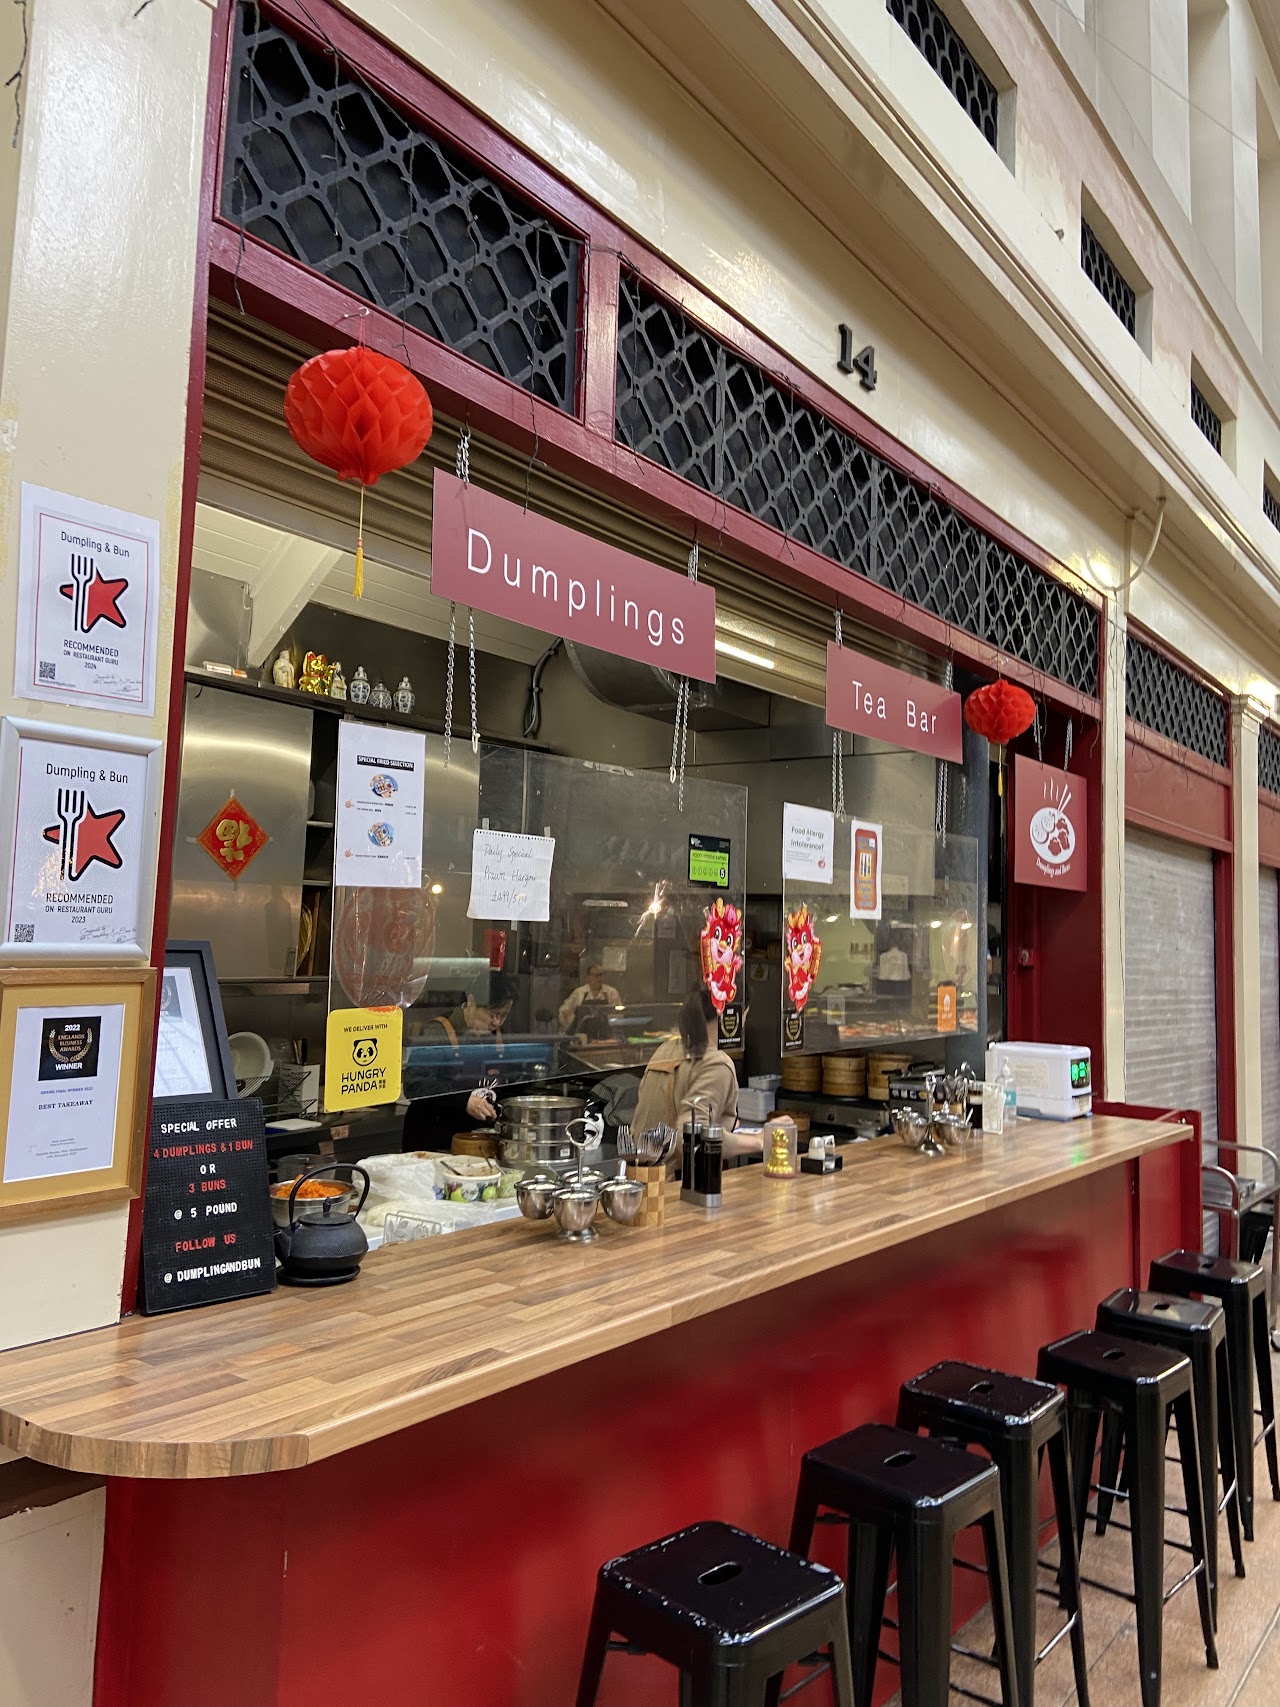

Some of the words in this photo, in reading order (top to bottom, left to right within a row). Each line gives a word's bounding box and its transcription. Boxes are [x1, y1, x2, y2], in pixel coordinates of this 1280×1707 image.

[837, 324, 877, 391] 14
[60, 531, 102, 553] Dumpling
[104, 543, 111, 553] &
[114, 545, 130, 558] Bun
[467, 528, 684, 647] Dumplings
[64, 639, 118, 658] RECOMMENDED
[73, 652, 104, 662] RESTAURANT
[84, 662, 96, 670] 2024
[852, 680, 886, 720] Tea
[906, 700, 936, 734] Bar
[390, 760, 414, 768] SELECTION
[46, 763, 95, 782] Dumpling
[100, 770, 106, 781] &
[110, 771, 128, 784] Bun
[792, 826, 806, 836] Food
[806, 829, 824, 840] Allergy
[790, 840, 824, 851] Intolerance?
[484, 844, 502, 862] Daily
[508, 847, 532, 863] Special
[484, 866, 506, 880] Prawn
[46, 892, 114, 904] RECOMMENDED
[58, 906, 96, 914] RESTAURANT
[56, 1062, 82, 1070] WINNER
[342, 1067, 386, 1082] HUNGRY
[342, 1080, 378, 1095] PANDA
[58, 1100, 93, 1108] TAKEAWAY
[160, 1122, 200, 1134] SPECIAL
[206, 1118, 237, 1130] OFFER
[153, 1148, 160, 1158] 4
[162, 1144, 217, 1158] DUMPLINGS
[220, 1142, 226, 1152] &
[228, 1142, 234, 1152] 1
[236, 1140, 253, 1150] BUN
[200, 1164, 216, 1174] OR
[188, 1183, 195, 1193] 3
[201, 1180, 226, 1192] BUNS
[174, 1210, 182, 1220] @
[190, 1207, 198, 1218] 5
[206, 1202, 238, 1216] POUND
[176, 1236, 216, 1252] FOLLOW
[224, 1234, 236, 1244] US
[164, 1273, 172, 1284] @
[176, 1257, 260, 1282] DUMPLINGANDBUN
